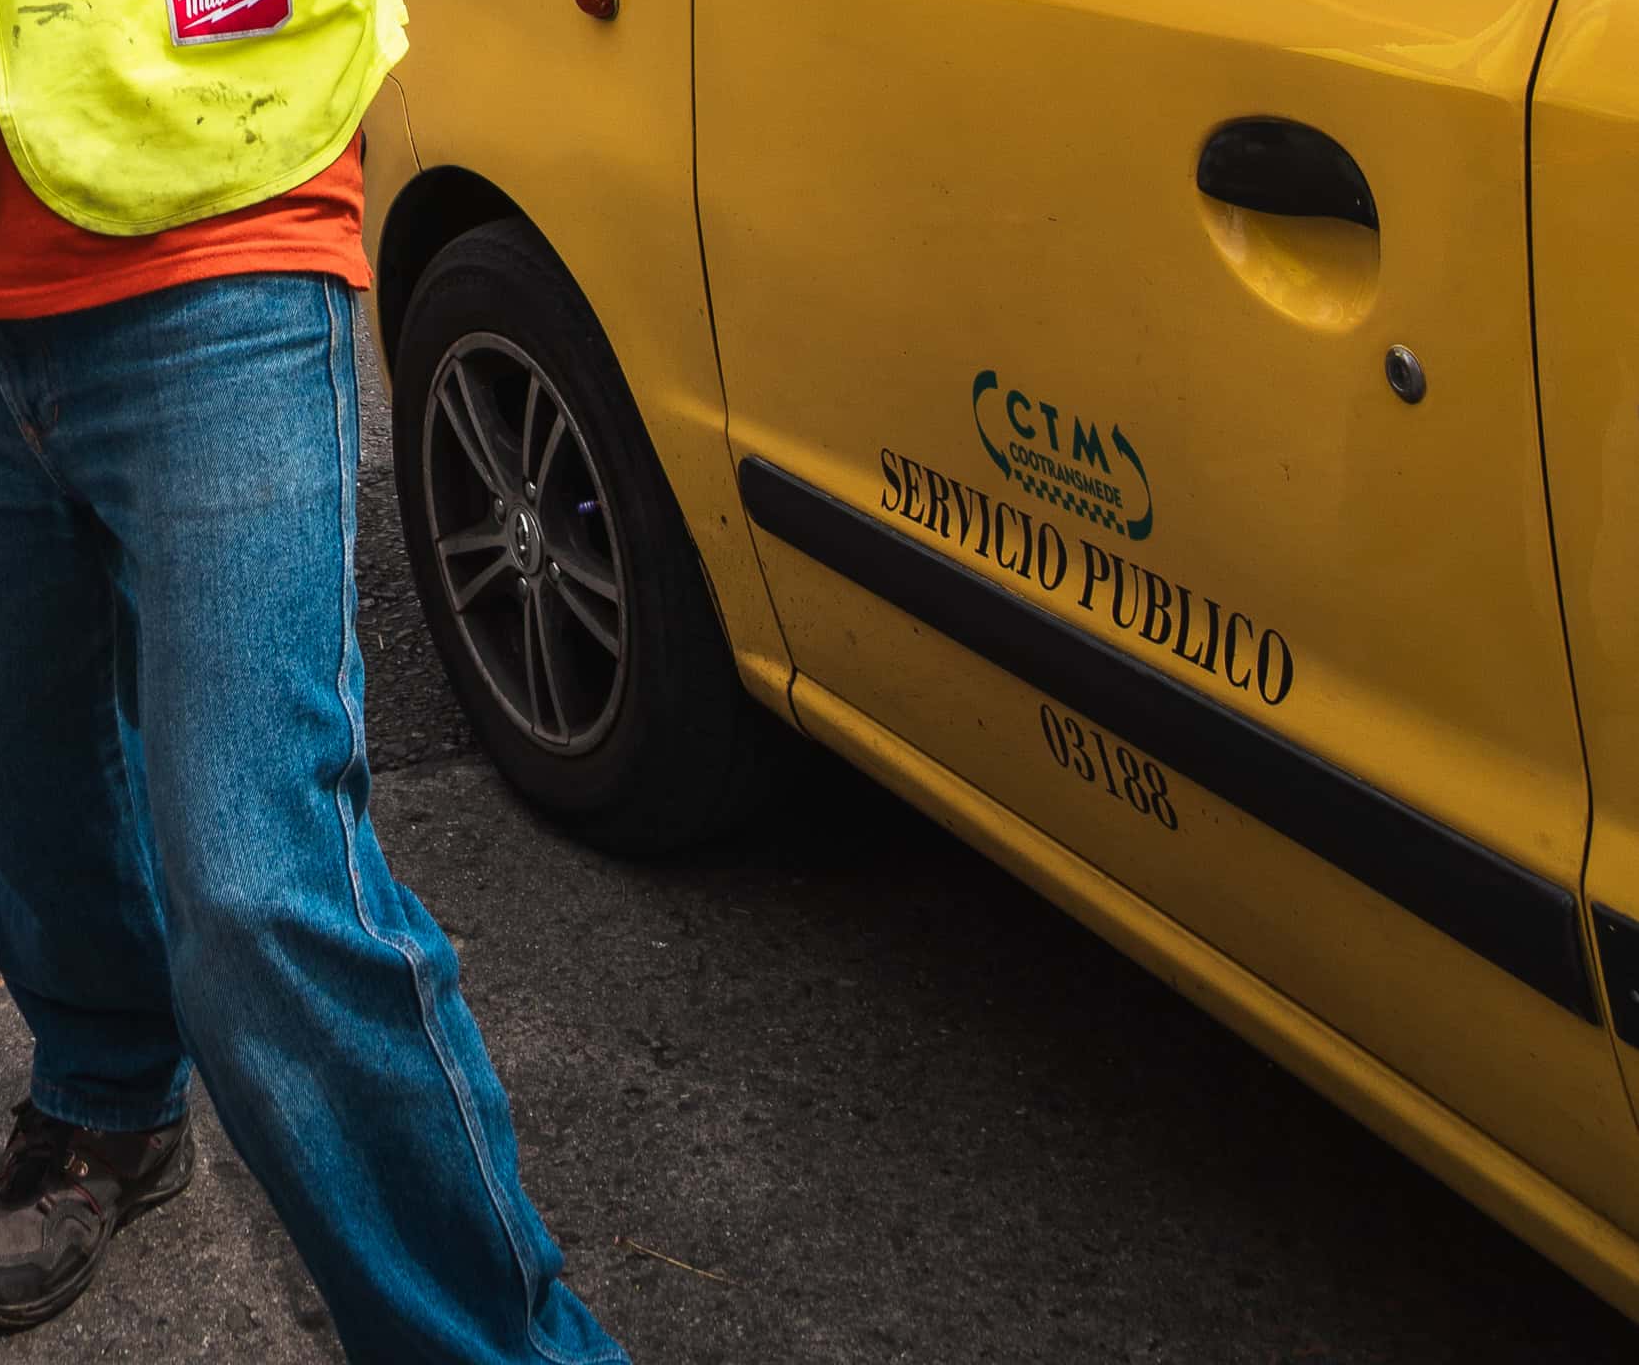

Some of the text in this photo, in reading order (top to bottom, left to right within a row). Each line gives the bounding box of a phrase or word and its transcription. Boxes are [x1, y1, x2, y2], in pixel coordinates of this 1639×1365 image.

[1010, 441, 1123, 509] COOTRANSMEDE
[880, 448, 1294, 706] SERVICIO PUBLICO
[1040, 703, 1178, 831] 03188
